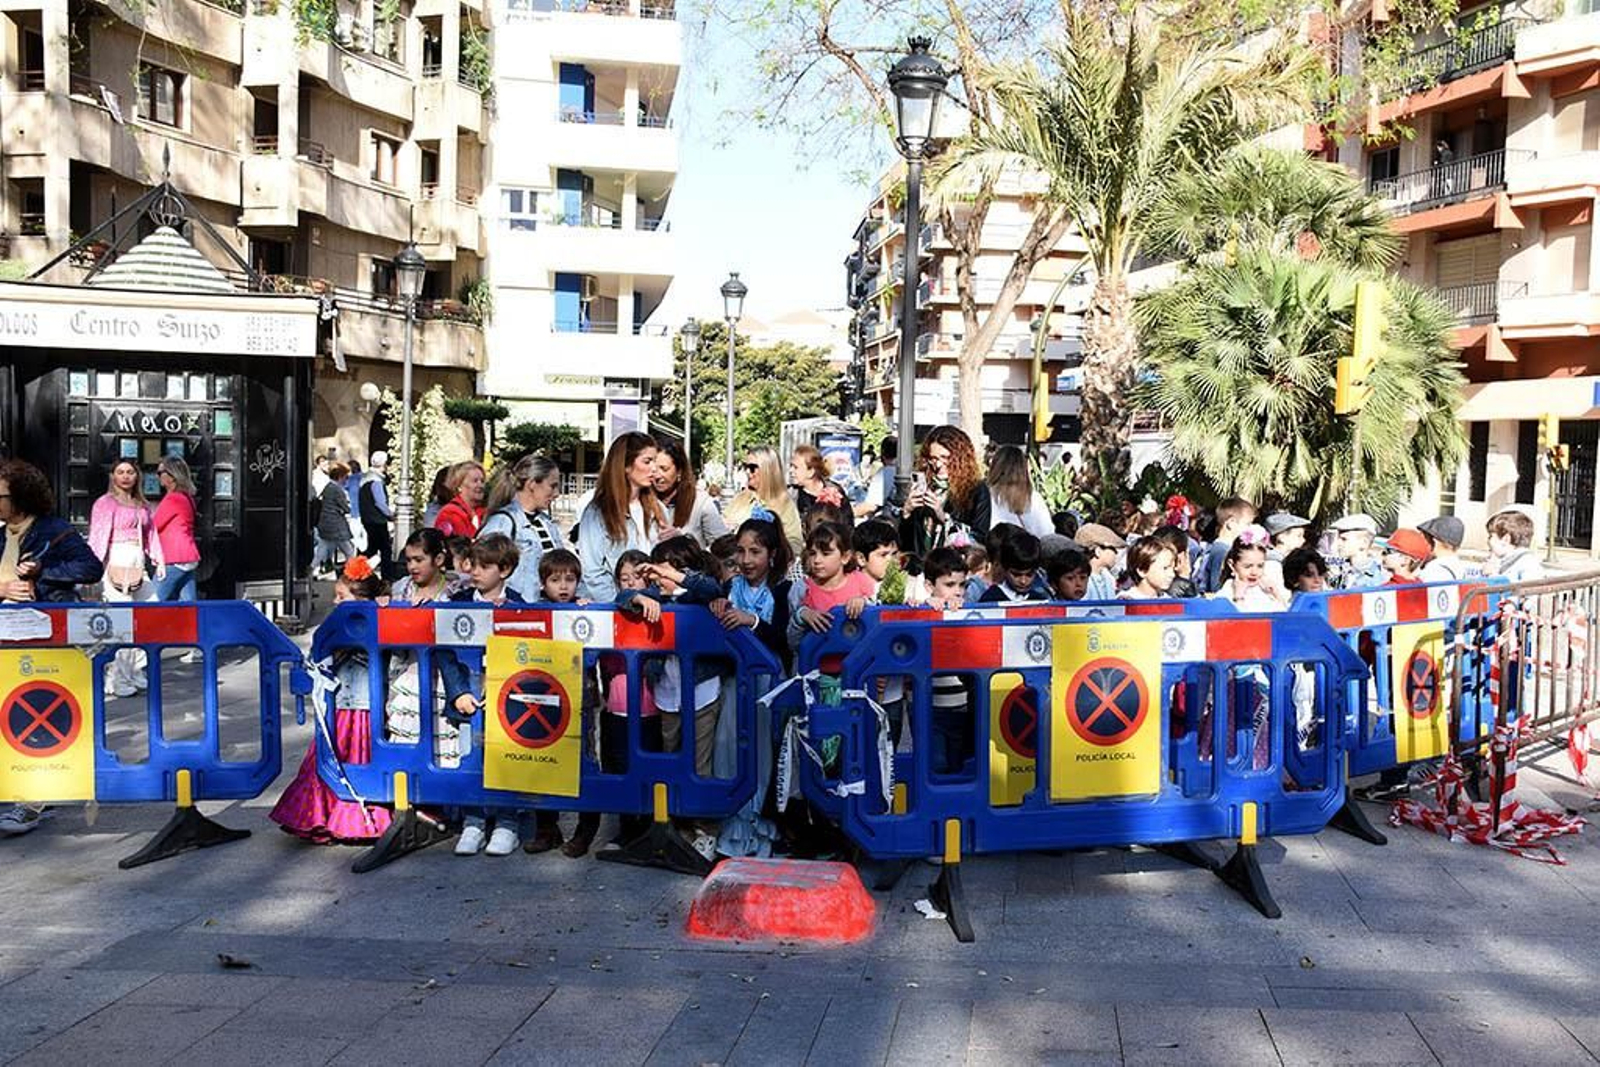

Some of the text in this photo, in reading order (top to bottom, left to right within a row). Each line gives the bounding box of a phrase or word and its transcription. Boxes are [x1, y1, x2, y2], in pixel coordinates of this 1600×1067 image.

[69, 309, 221, 346] Centro Suizo
[1110, 752, 1136, 760] LOCAL
